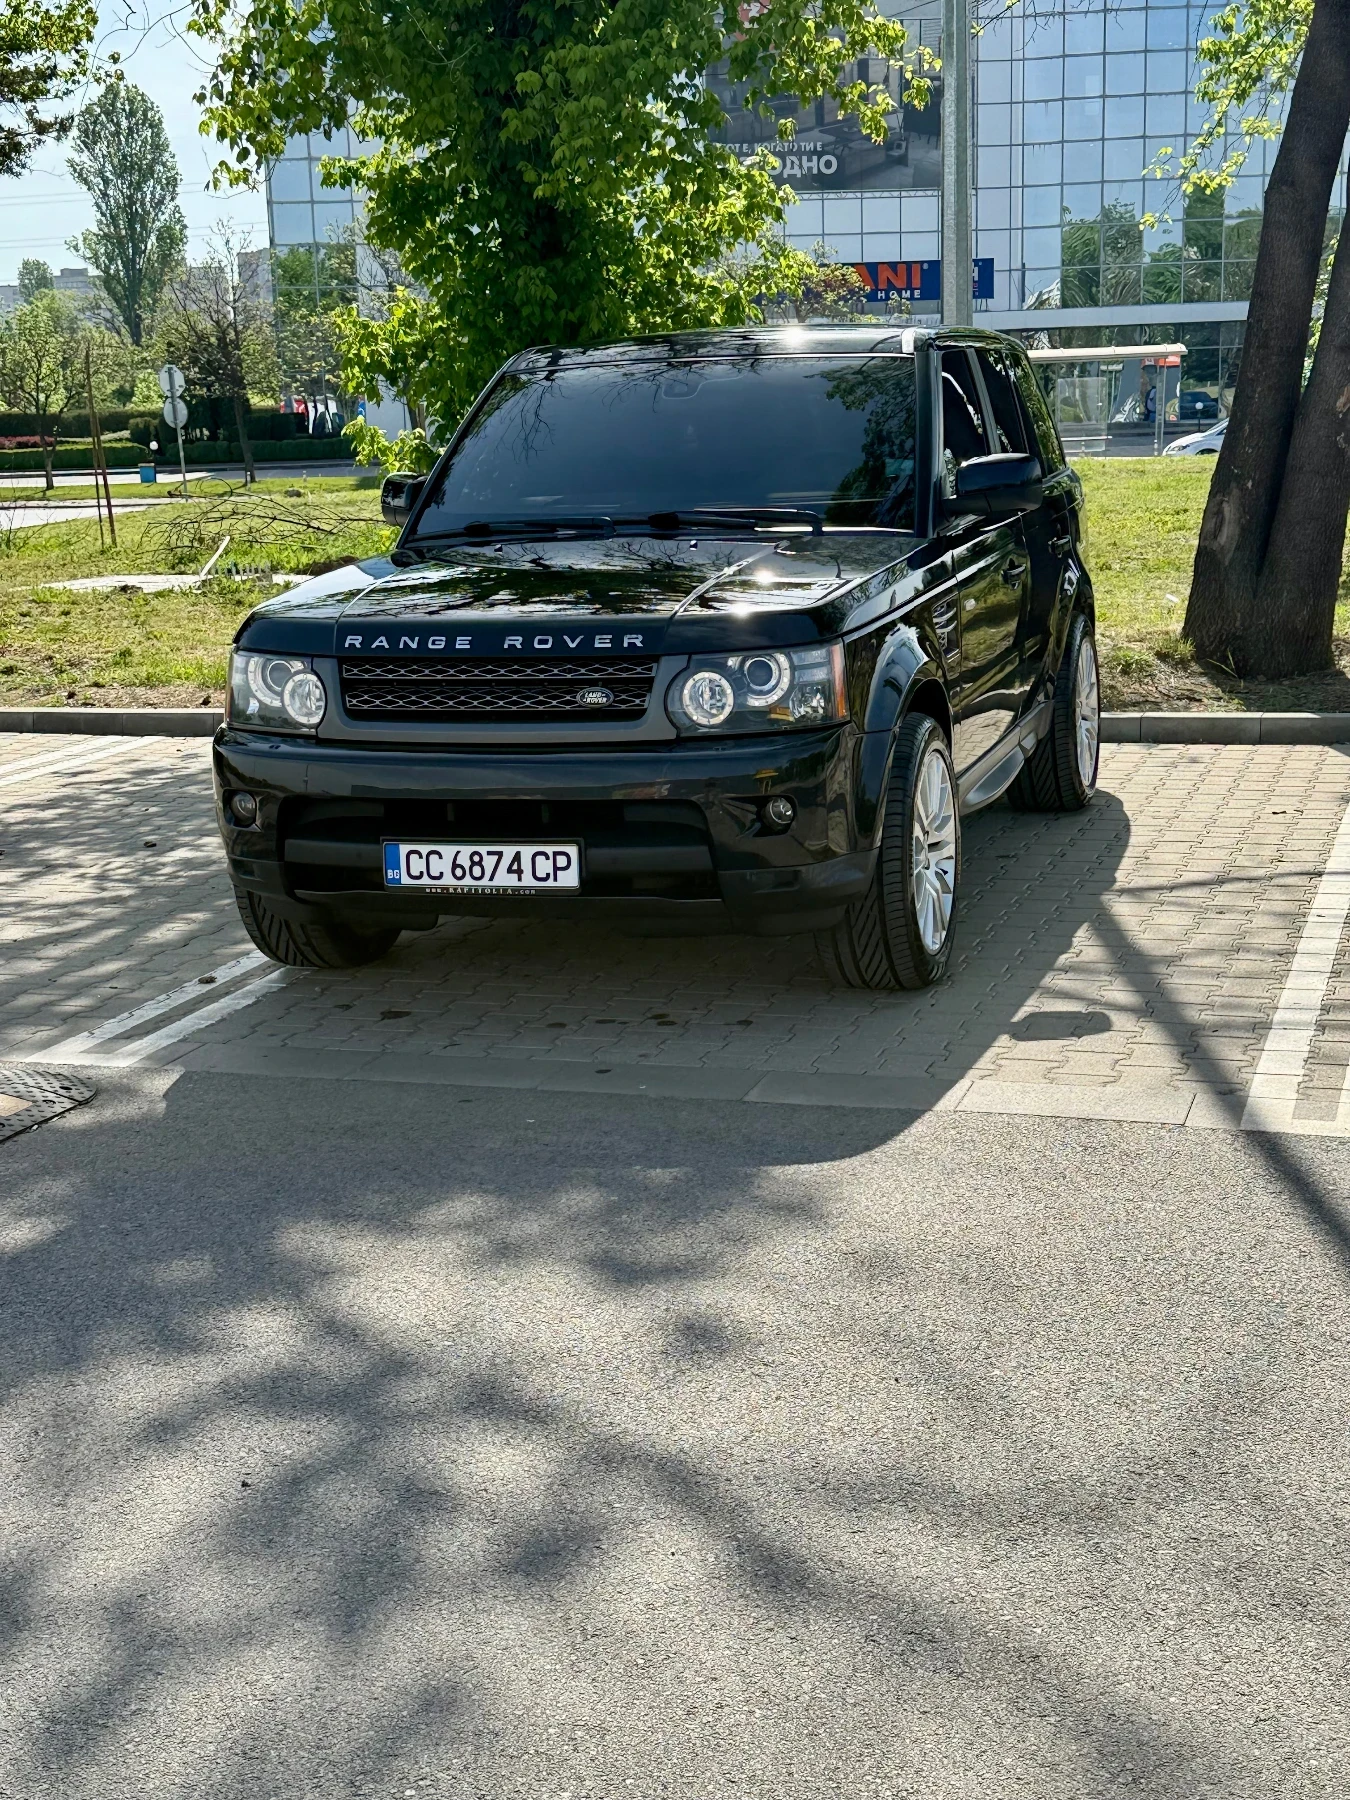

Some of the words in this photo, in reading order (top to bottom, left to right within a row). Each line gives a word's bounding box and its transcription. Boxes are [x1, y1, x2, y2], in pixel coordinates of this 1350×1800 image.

[801, 142, 814, 152] ТИ
[817, 142, 823, 151] Е
[878, 289, 921, 299] HOME
[345, 635, 473, 649] RANGE
[503, 634, 644, 649] ROVER
[387, 869, 400, 879] BG
